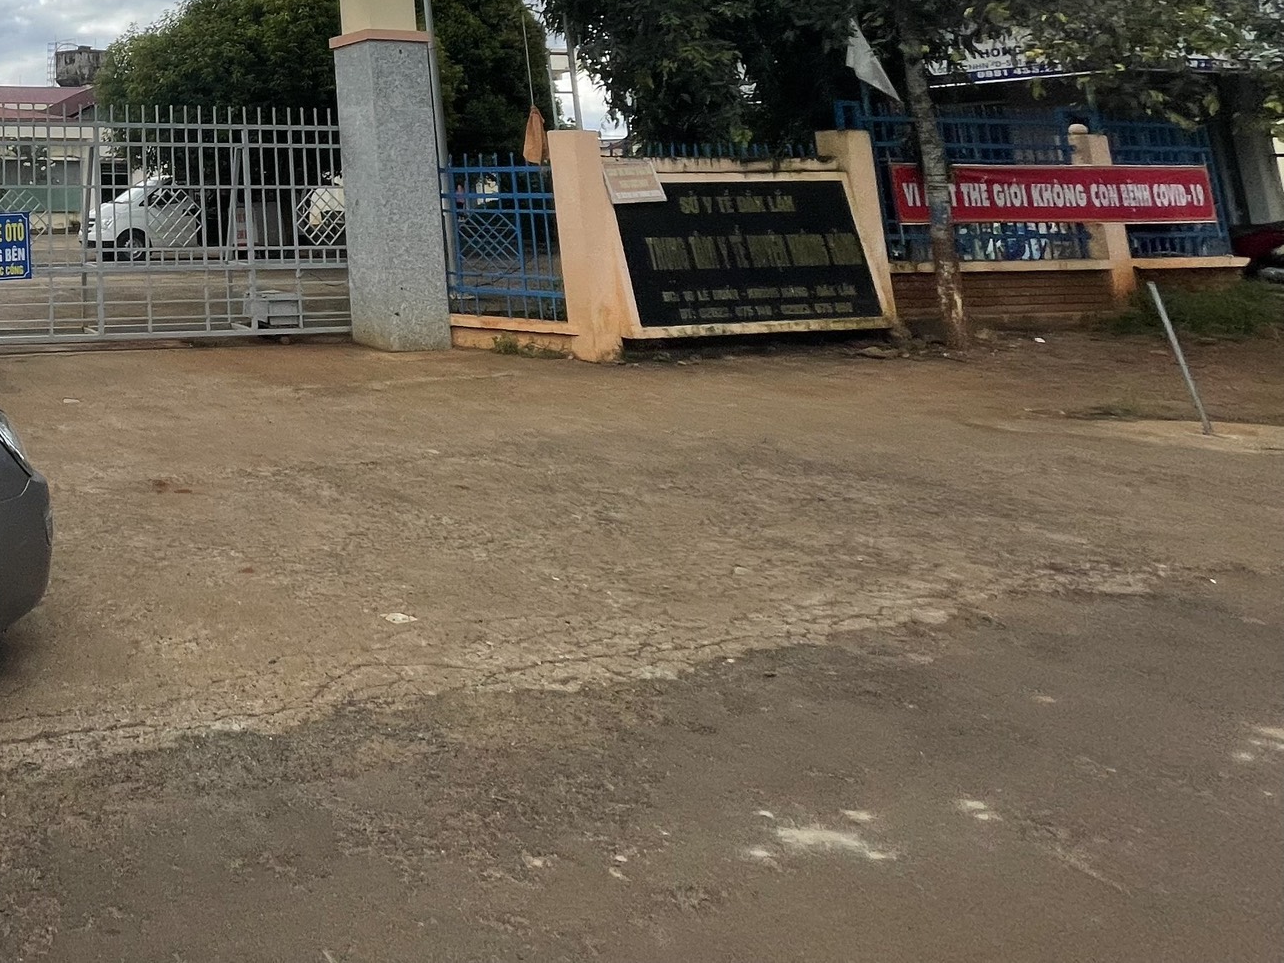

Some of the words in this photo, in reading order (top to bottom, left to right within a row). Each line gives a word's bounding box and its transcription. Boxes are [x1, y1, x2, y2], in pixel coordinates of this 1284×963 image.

[959, 176, 991, 207] THẾ
[992, 177, 1029, 208] GIỚI
[1030, 178, 1088, 207] KHÔNG
[1090, 178, 1120, 208] CÒN
[1120, 178, 1153, 212] BỆNH
[1153, 183, 1205, 208] COVID-19
[4, 218, 25, 242] ÔTÔ
[4, 245, 26, 262] BÊN
